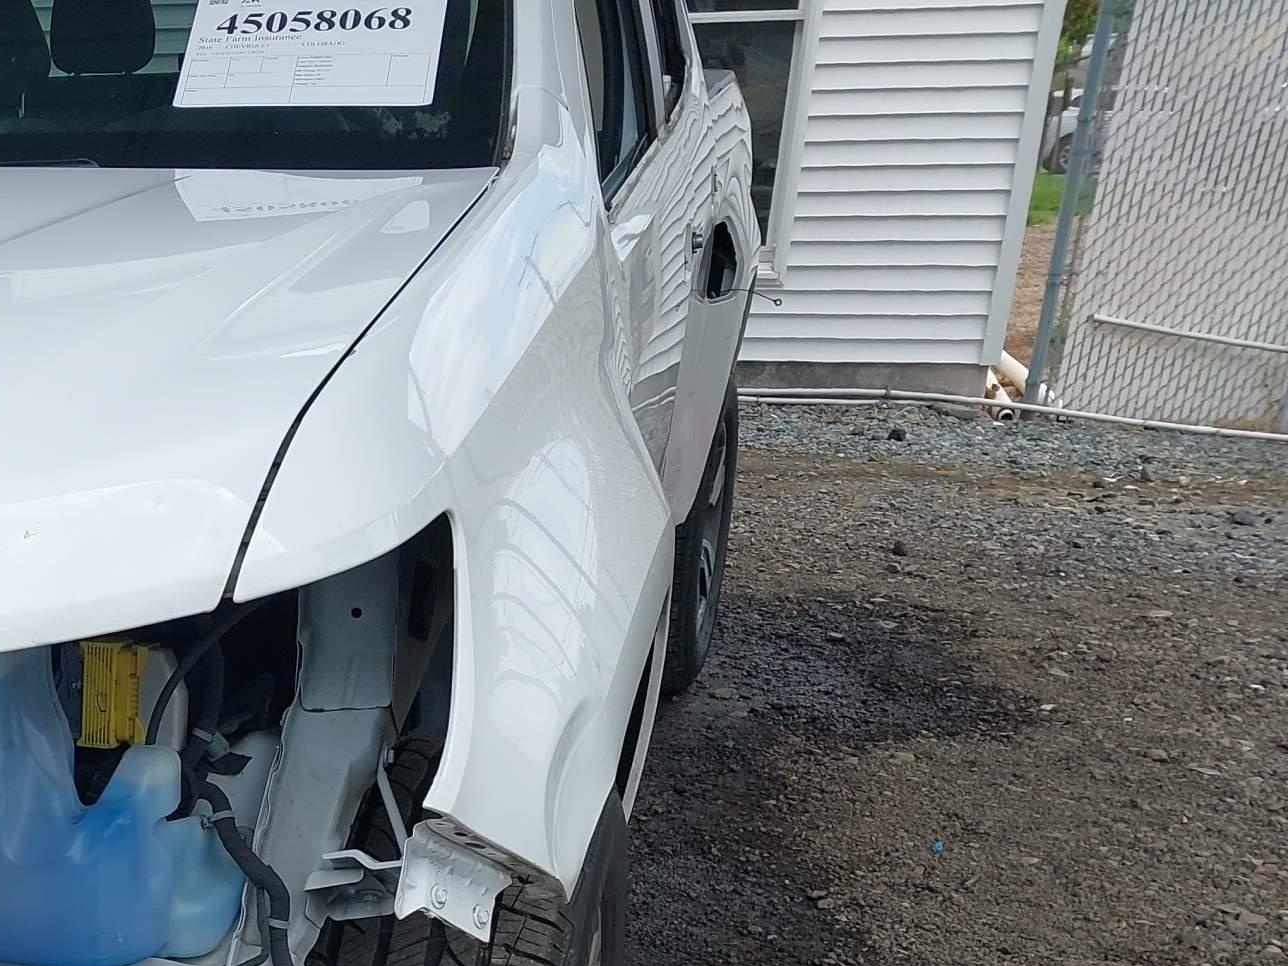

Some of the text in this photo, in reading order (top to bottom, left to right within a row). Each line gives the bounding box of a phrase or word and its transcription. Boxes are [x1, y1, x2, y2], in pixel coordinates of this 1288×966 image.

[216, 7, 412, 35] 45058068
[198, 34, 302, 44] State Farm Insurance
